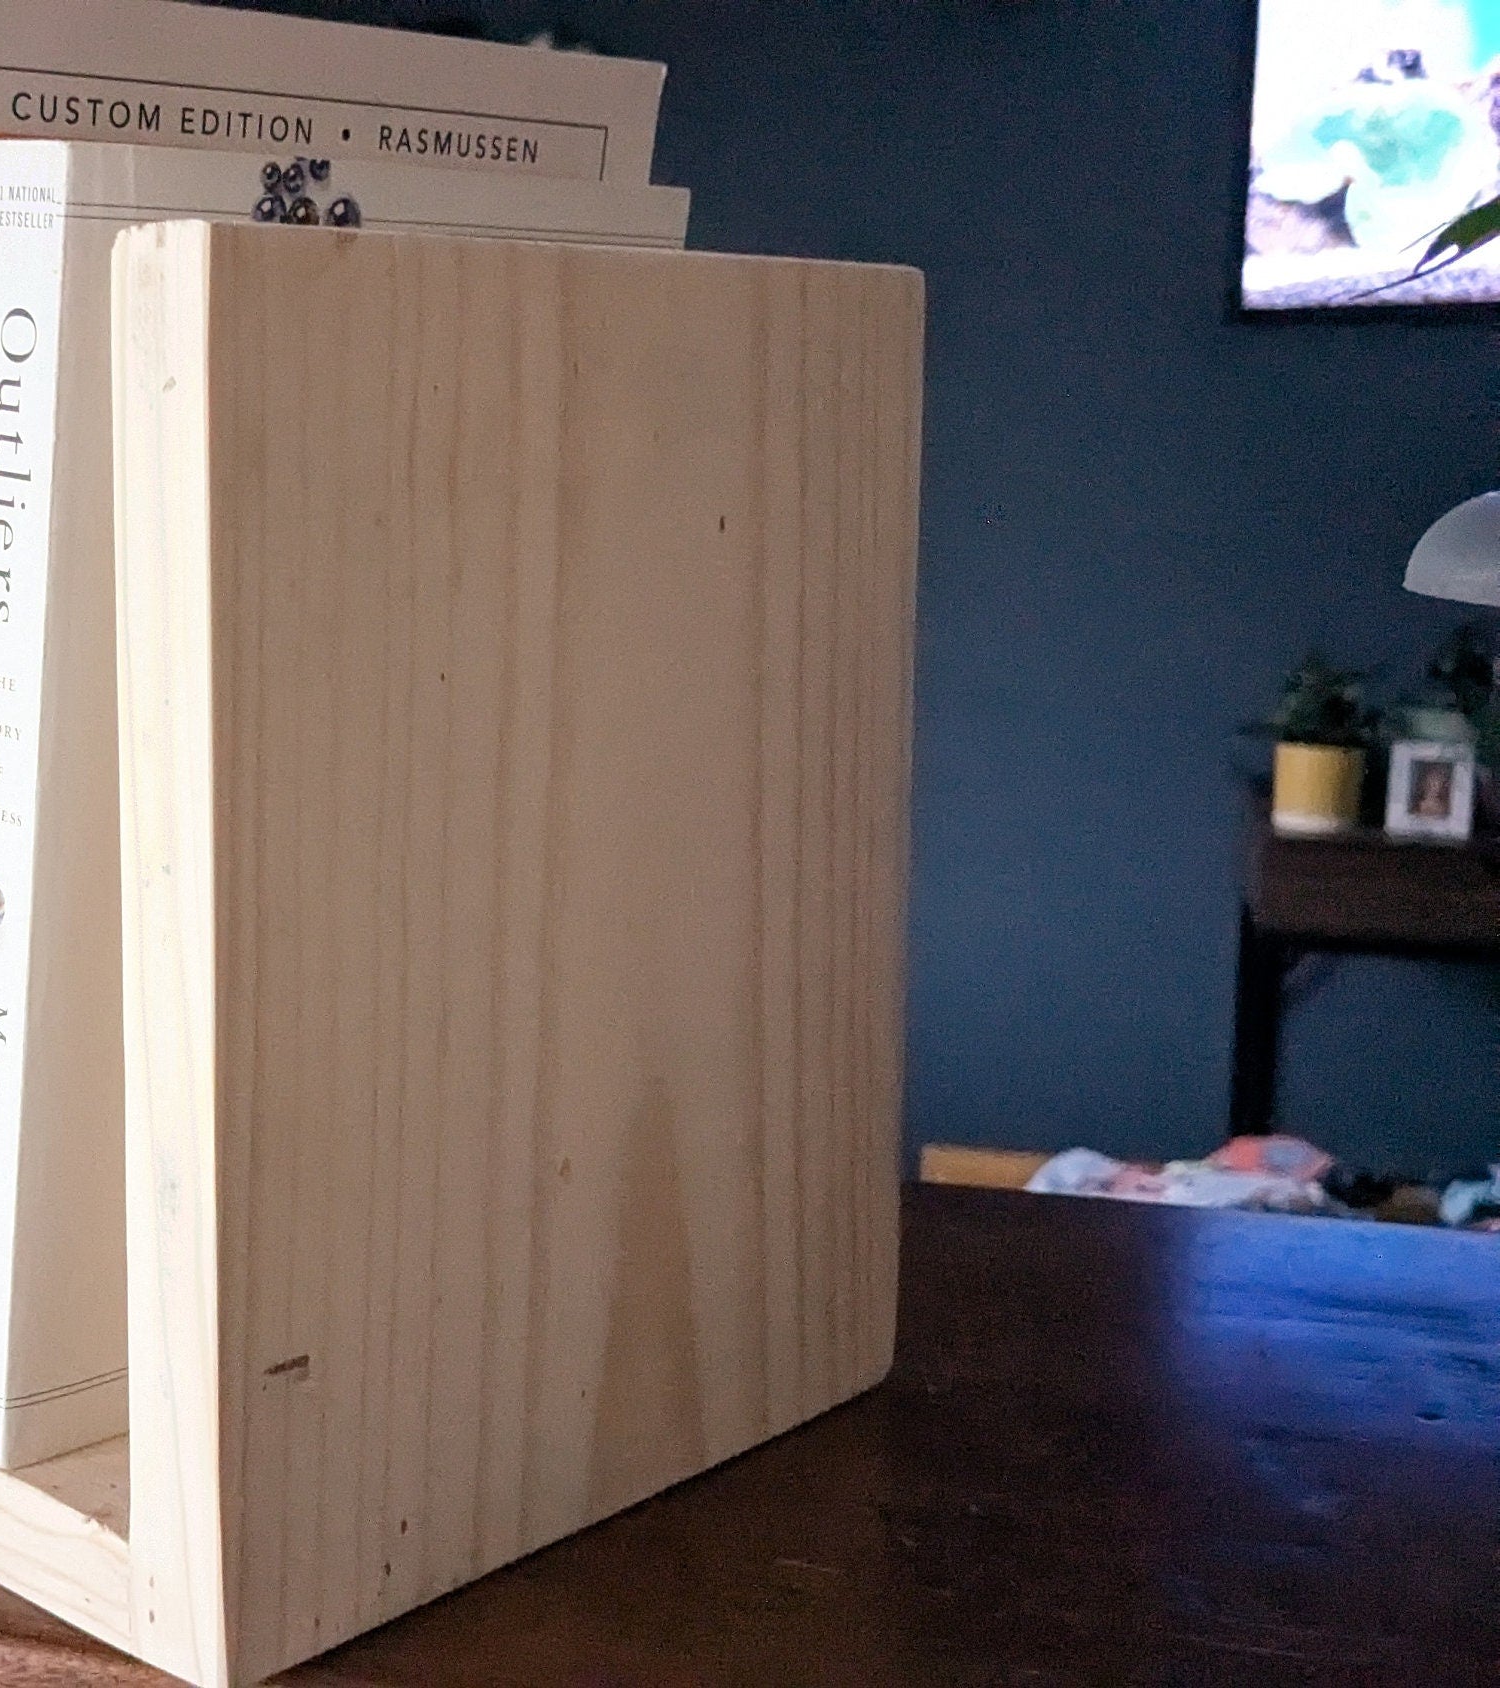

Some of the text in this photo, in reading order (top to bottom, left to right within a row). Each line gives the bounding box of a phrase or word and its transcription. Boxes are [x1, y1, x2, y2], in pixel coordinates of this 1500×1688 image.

[11, 92, 540, 165] CUSTOM EDITION RASMUSSEN
[8, 186, 56, 203] NATIONAL
